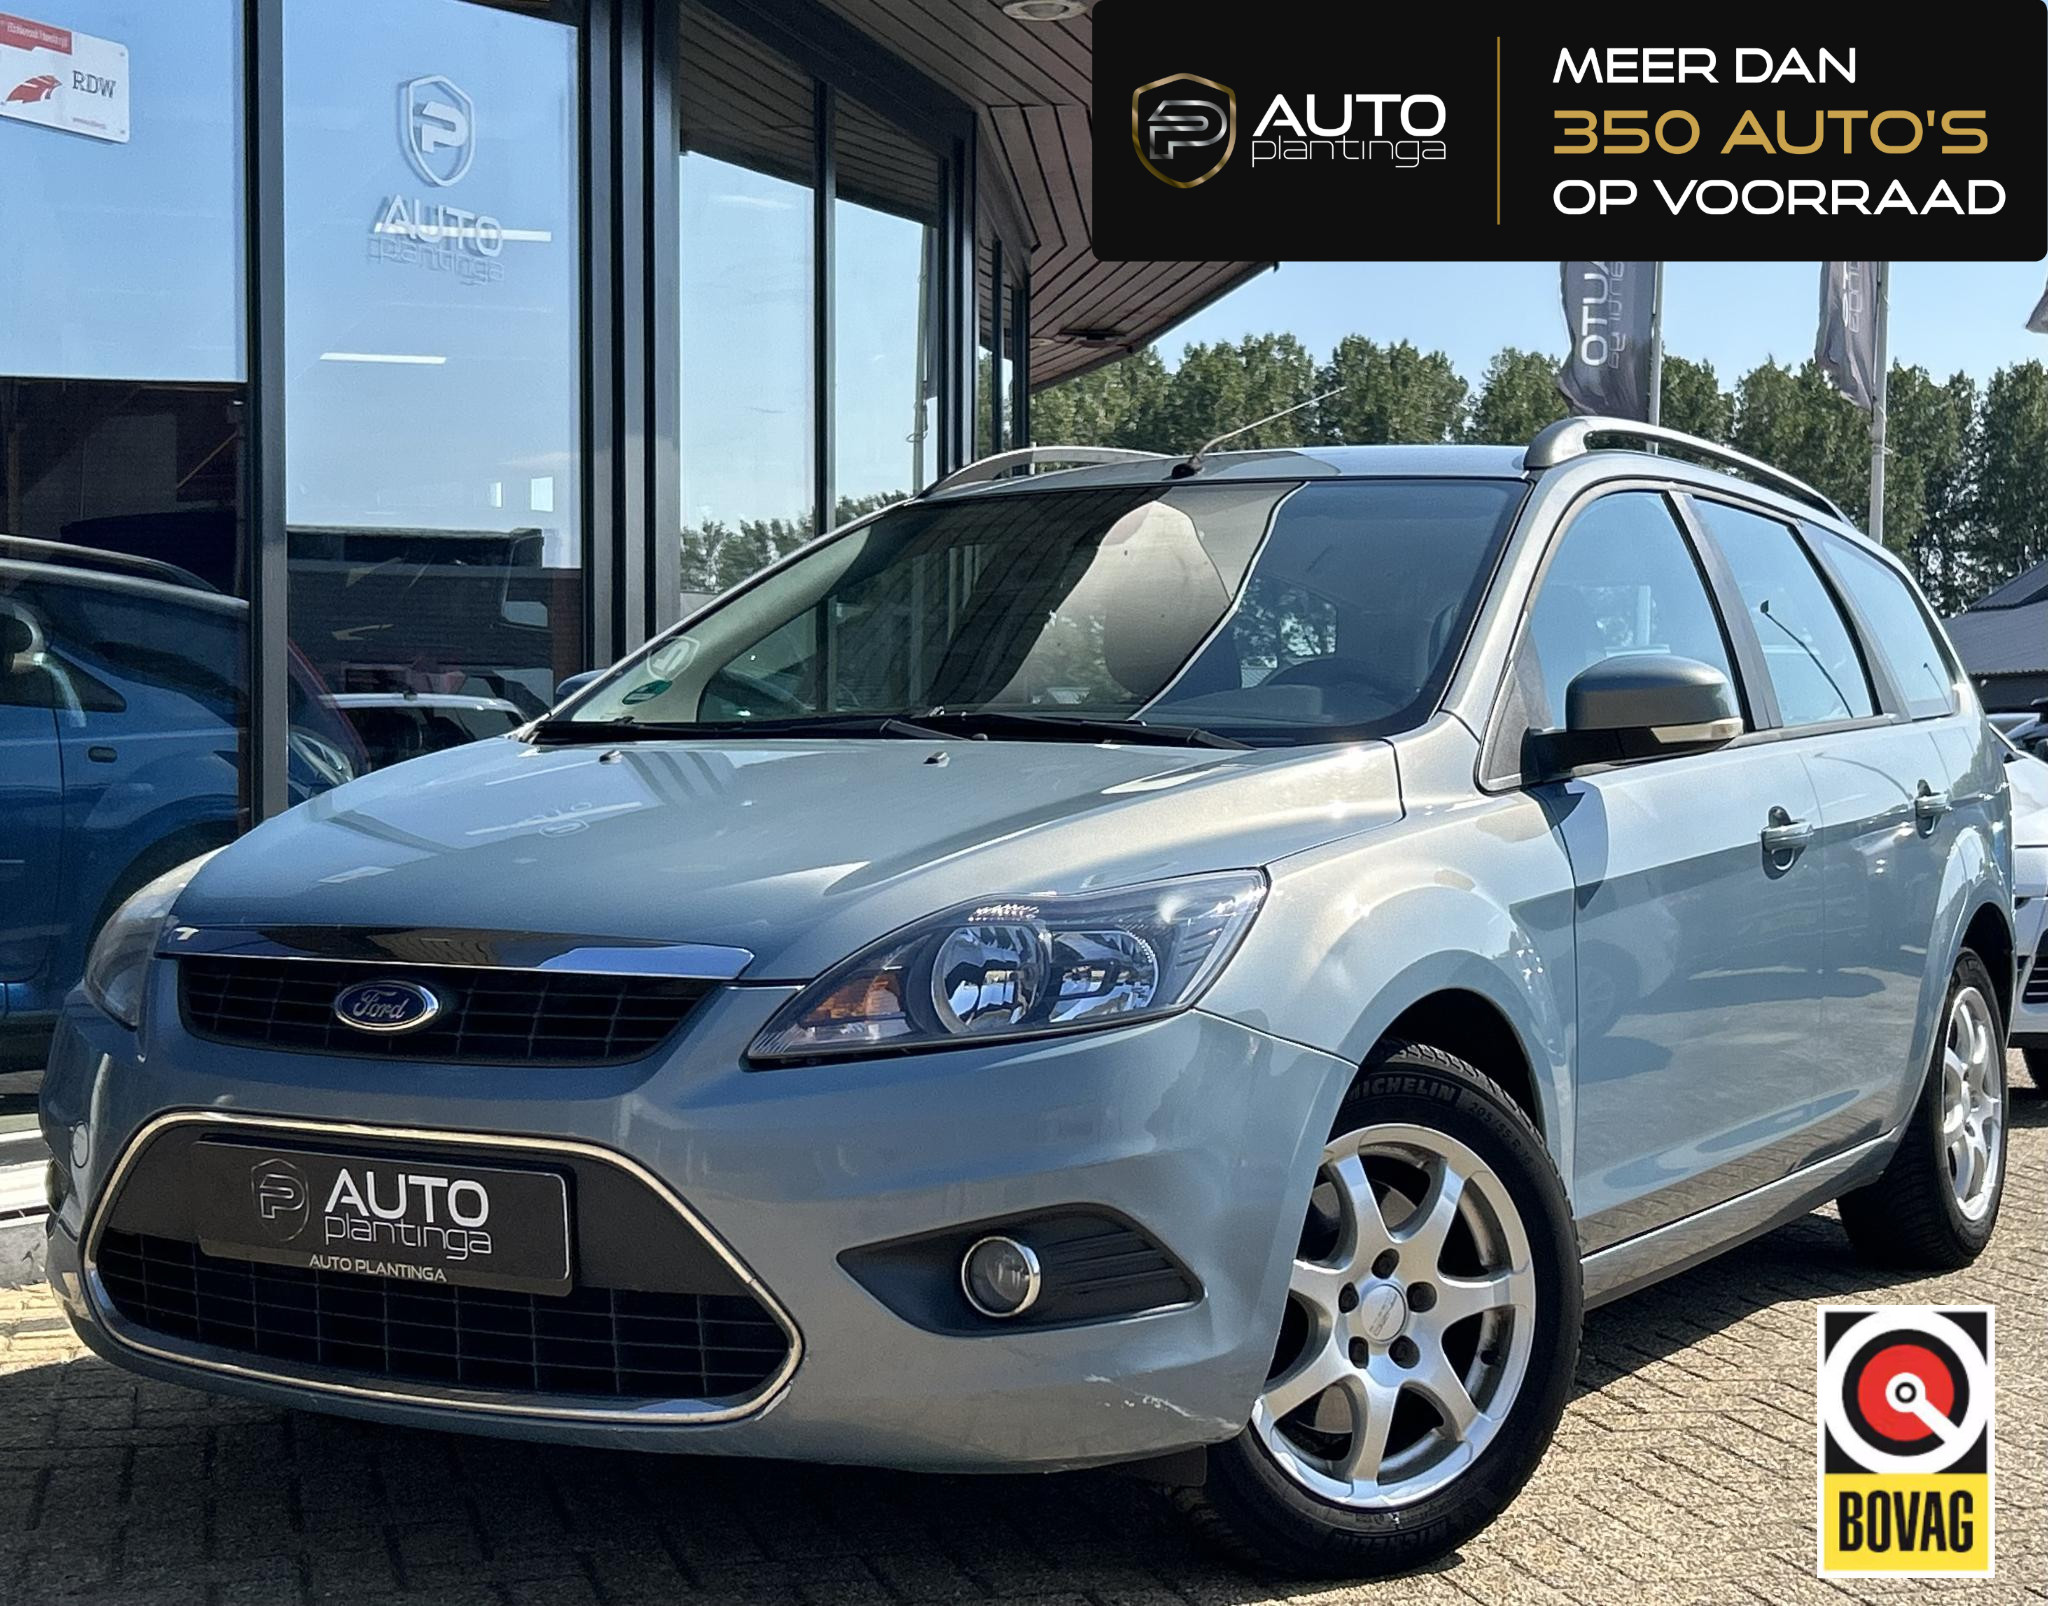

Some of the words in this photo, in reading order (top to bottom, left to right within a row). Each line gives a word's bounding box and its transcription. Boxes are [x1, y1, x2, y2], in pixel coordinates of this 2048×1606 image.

[72, 70, 116, 98] RDW
[383, 194, 503, 258] AUTO
[353, 989, 410, 1018] Ford
[1351, 1076, 1457, 1101] MICHELIN
[324, 1168, 490, 1229] AUTO
[324, 1213, 492, 1261] plantinga
[308, 1253, 352, 1272] AUTO
[355, 1259, 447, 1282] PLANTINGA
